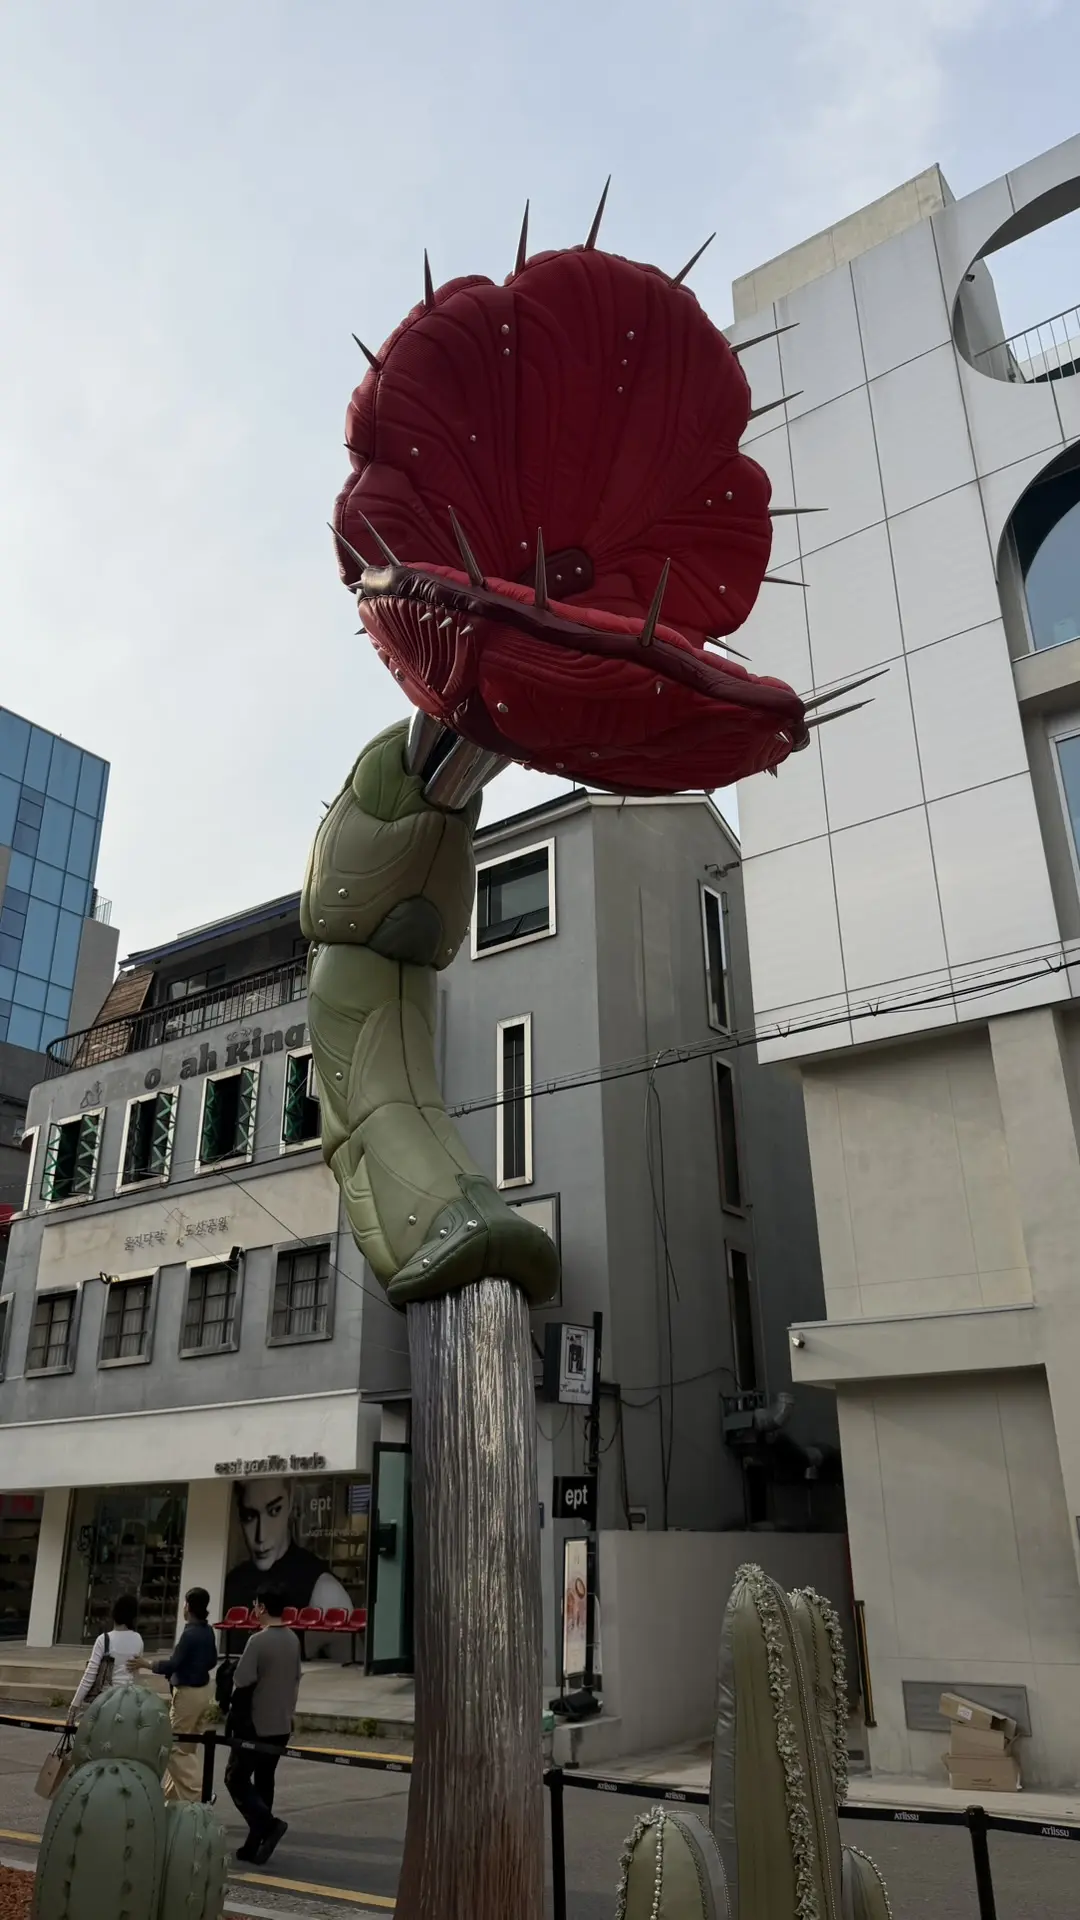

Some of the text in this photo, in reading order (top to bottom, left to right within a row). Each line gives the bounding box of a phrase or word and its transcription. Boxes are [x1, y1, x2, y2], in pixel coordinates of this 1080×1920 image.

[225, 1023, 306, 1067] King
[290, 1452, 326, 1471] trade
[565, 1485, 588, 1509] ept
[310, 1496, 331, 1528] ept
